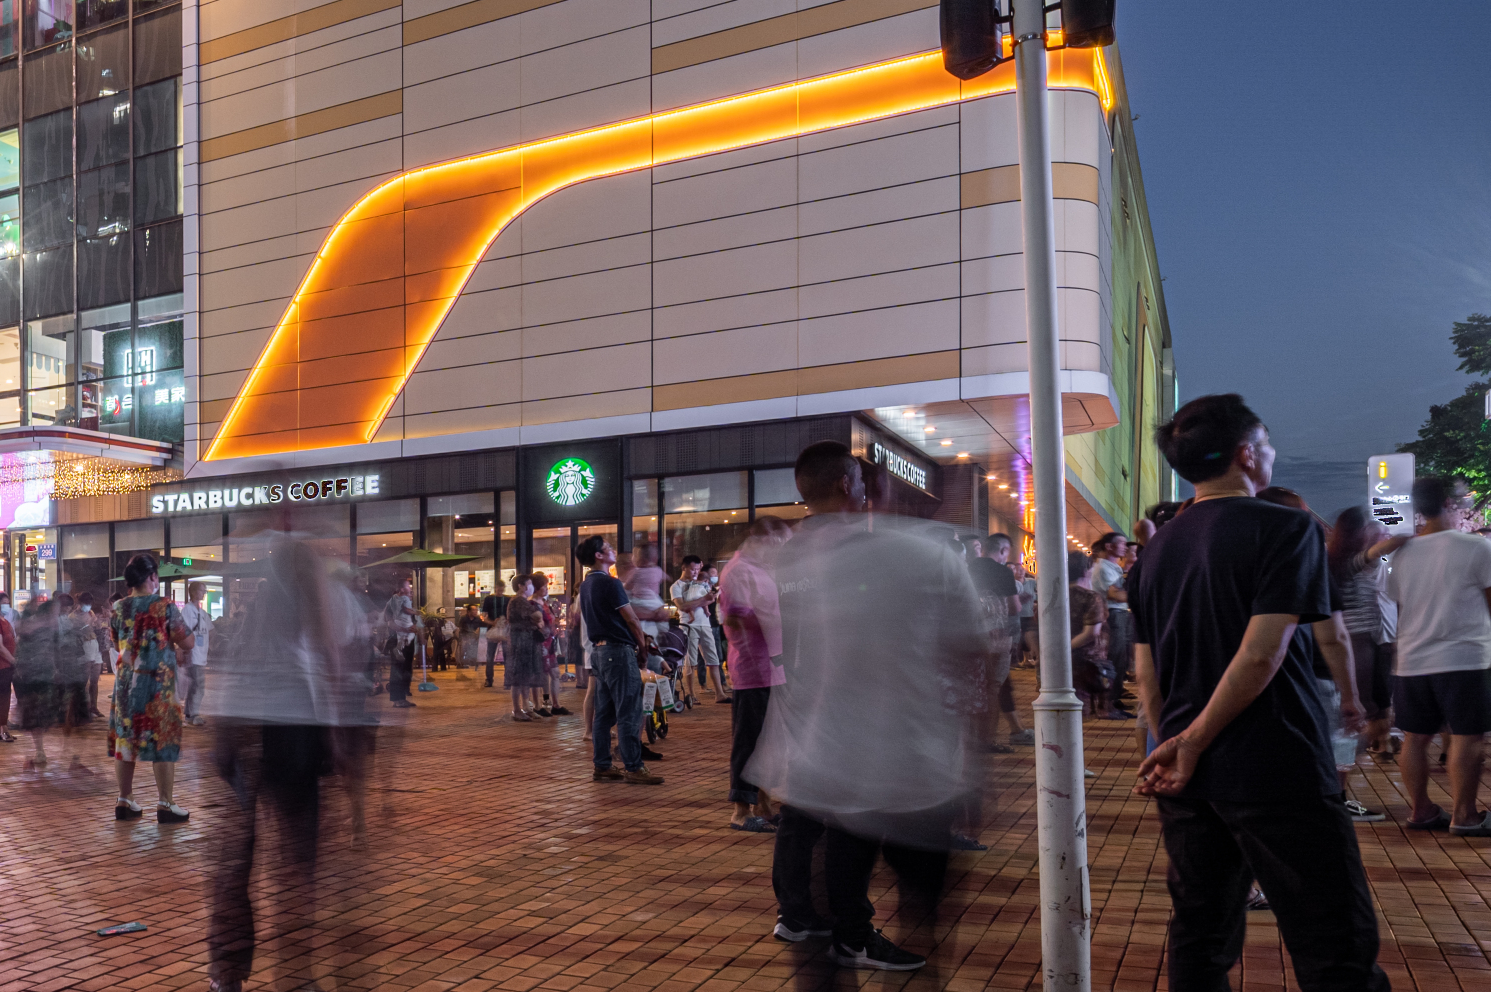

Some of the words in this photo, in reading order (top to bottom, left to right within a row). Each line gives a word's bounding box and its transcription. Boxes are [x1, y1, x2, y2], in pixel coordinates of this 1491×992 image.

[907, 461, 926, 490] COFFEE
[151, 484, 284, 514] STARBUCKS
[288, 474, 380, 502] COFFEE
[41, 548, 53, 557] 299
